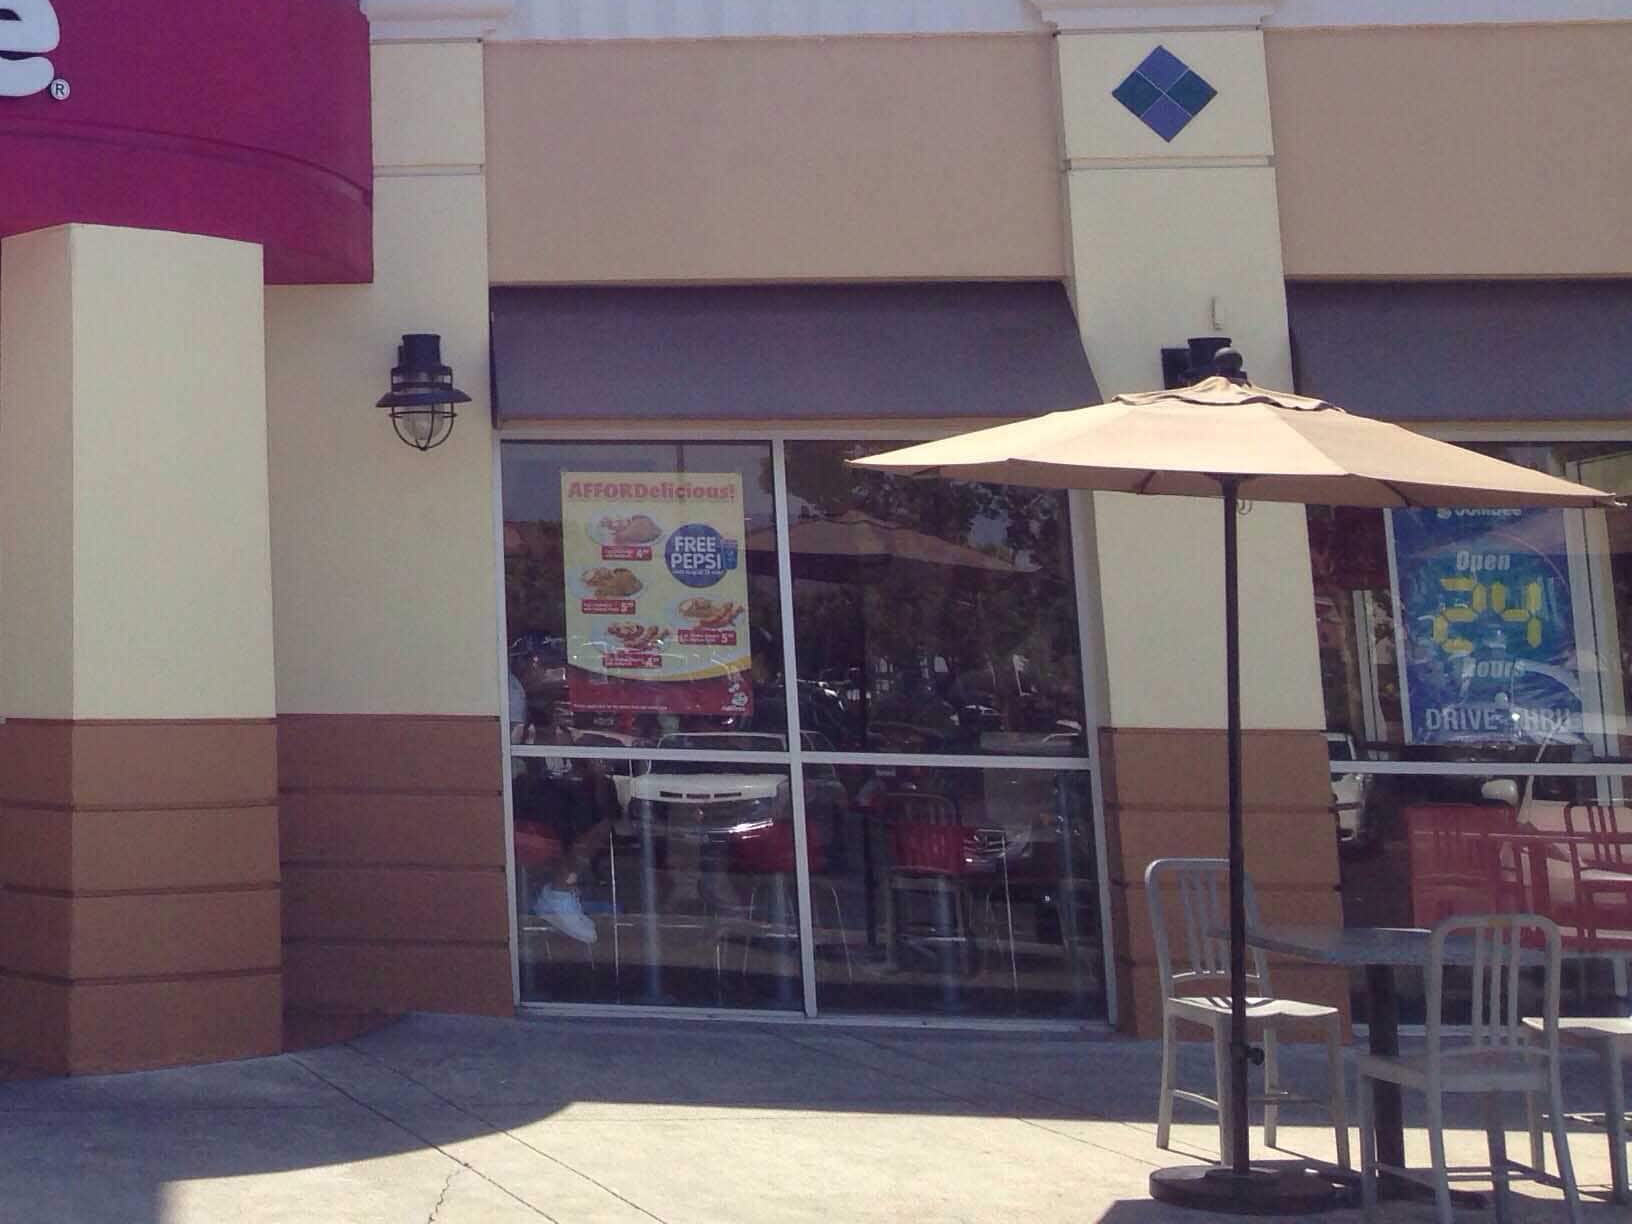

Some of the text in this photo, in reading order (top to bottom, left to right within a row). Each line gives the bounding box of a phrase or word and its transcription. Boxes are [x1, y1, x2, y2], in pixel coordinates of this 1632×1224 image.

[674, 536, 717, 552] FREE
[671, 553, 722, 569] PEPSI
[1456, 550, 1511, 572] Open
[1432, 576, 1543, 654] 24
[1425, 707, 1497, 731] DRIVE
